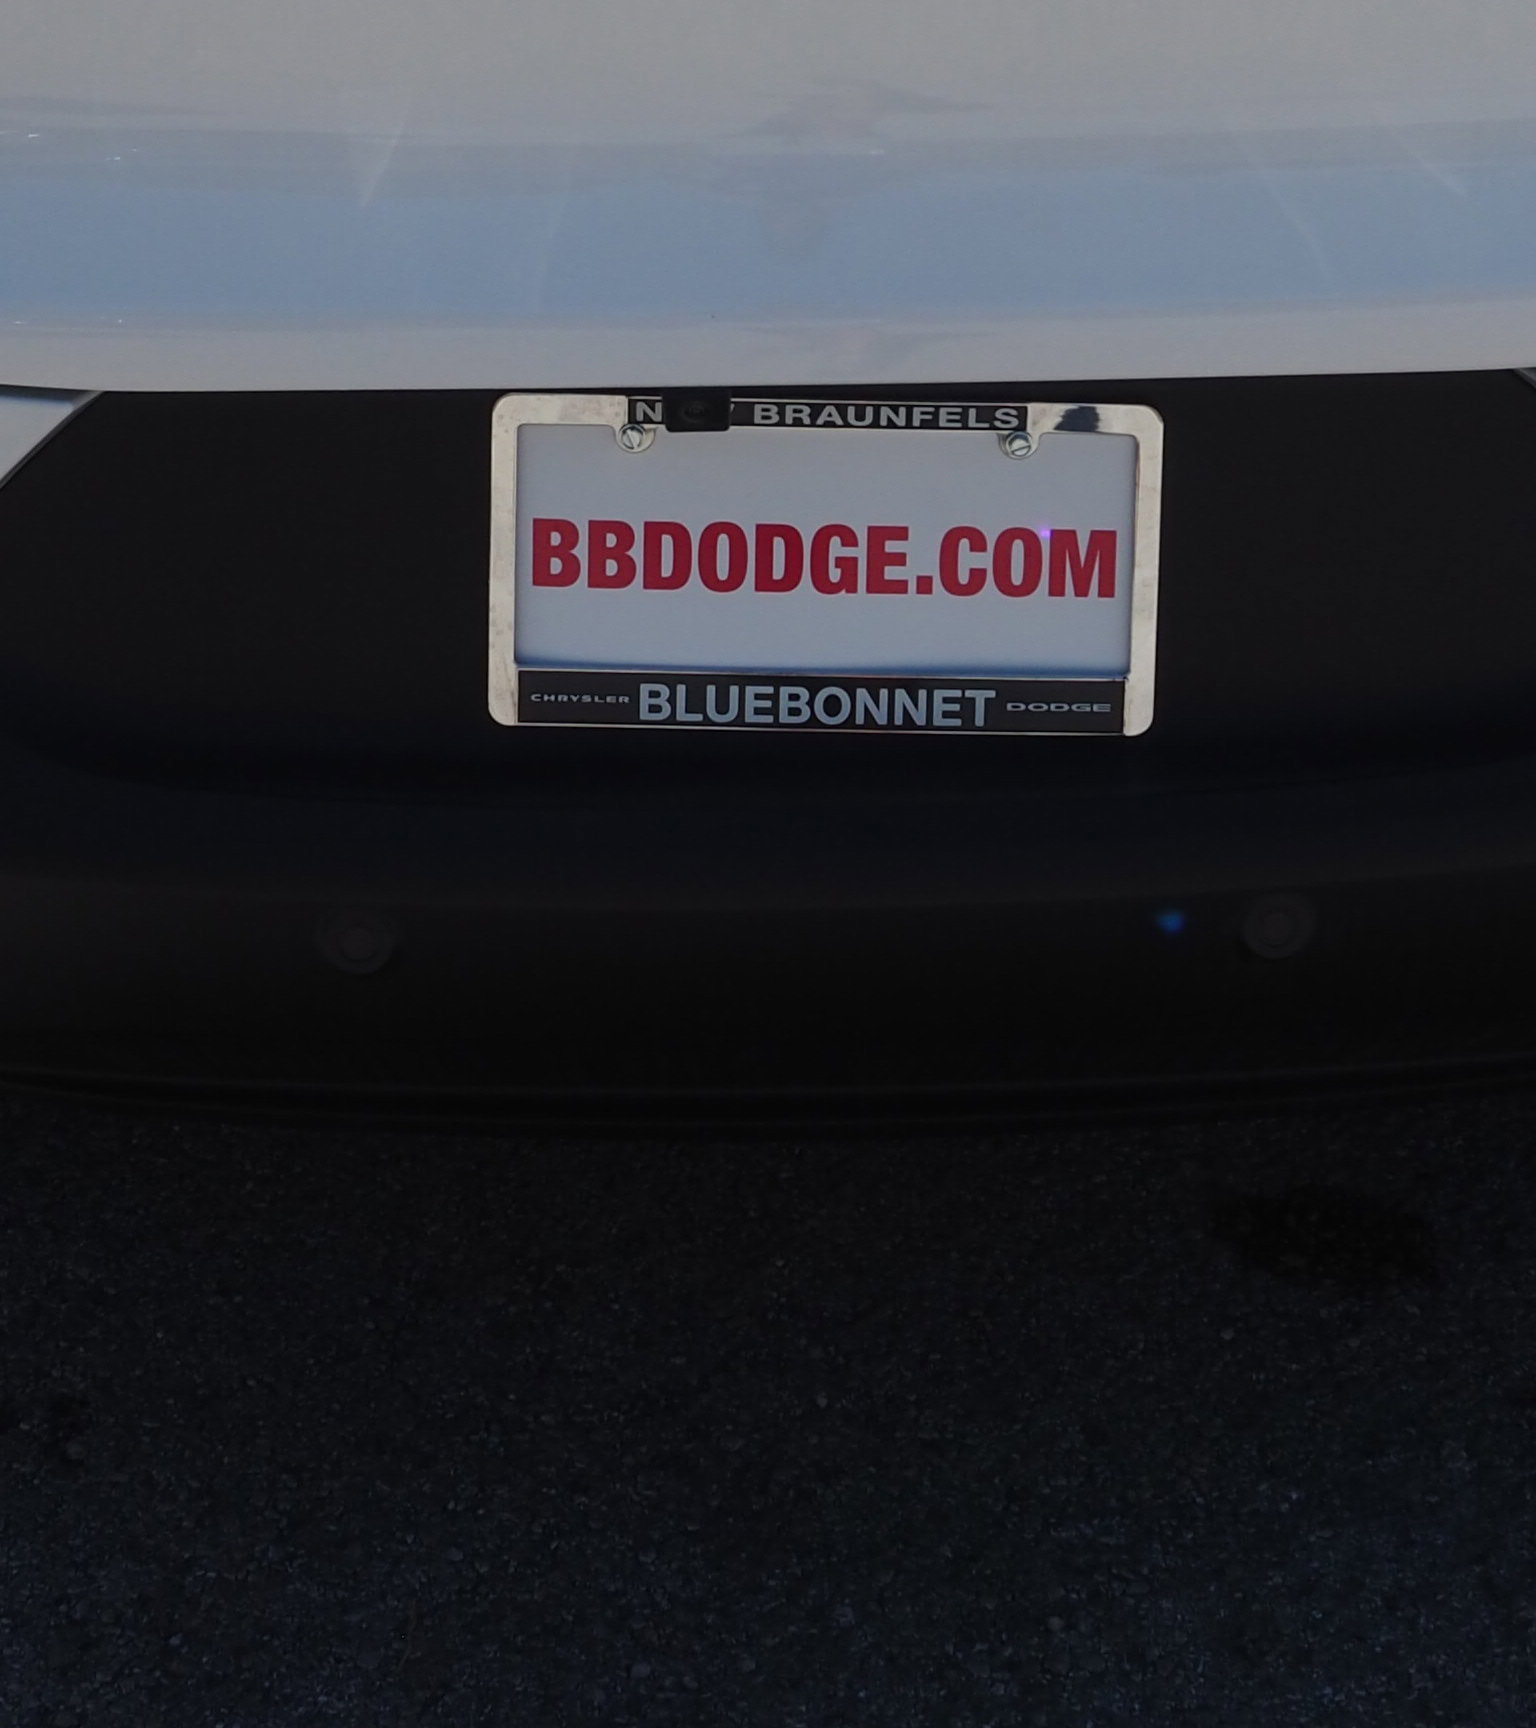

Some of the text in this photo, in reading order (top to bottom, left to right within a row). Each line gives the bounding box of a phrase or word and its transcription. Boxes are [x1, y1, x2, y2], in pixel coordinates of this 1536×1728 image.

[753, 403, 1020, 429] BRAUNFELS
[531, 518, 1118, 598] BBDODGE.COM
[530, 683, 1111, 727] CHRYSLER BLUEBONNET DODGE
